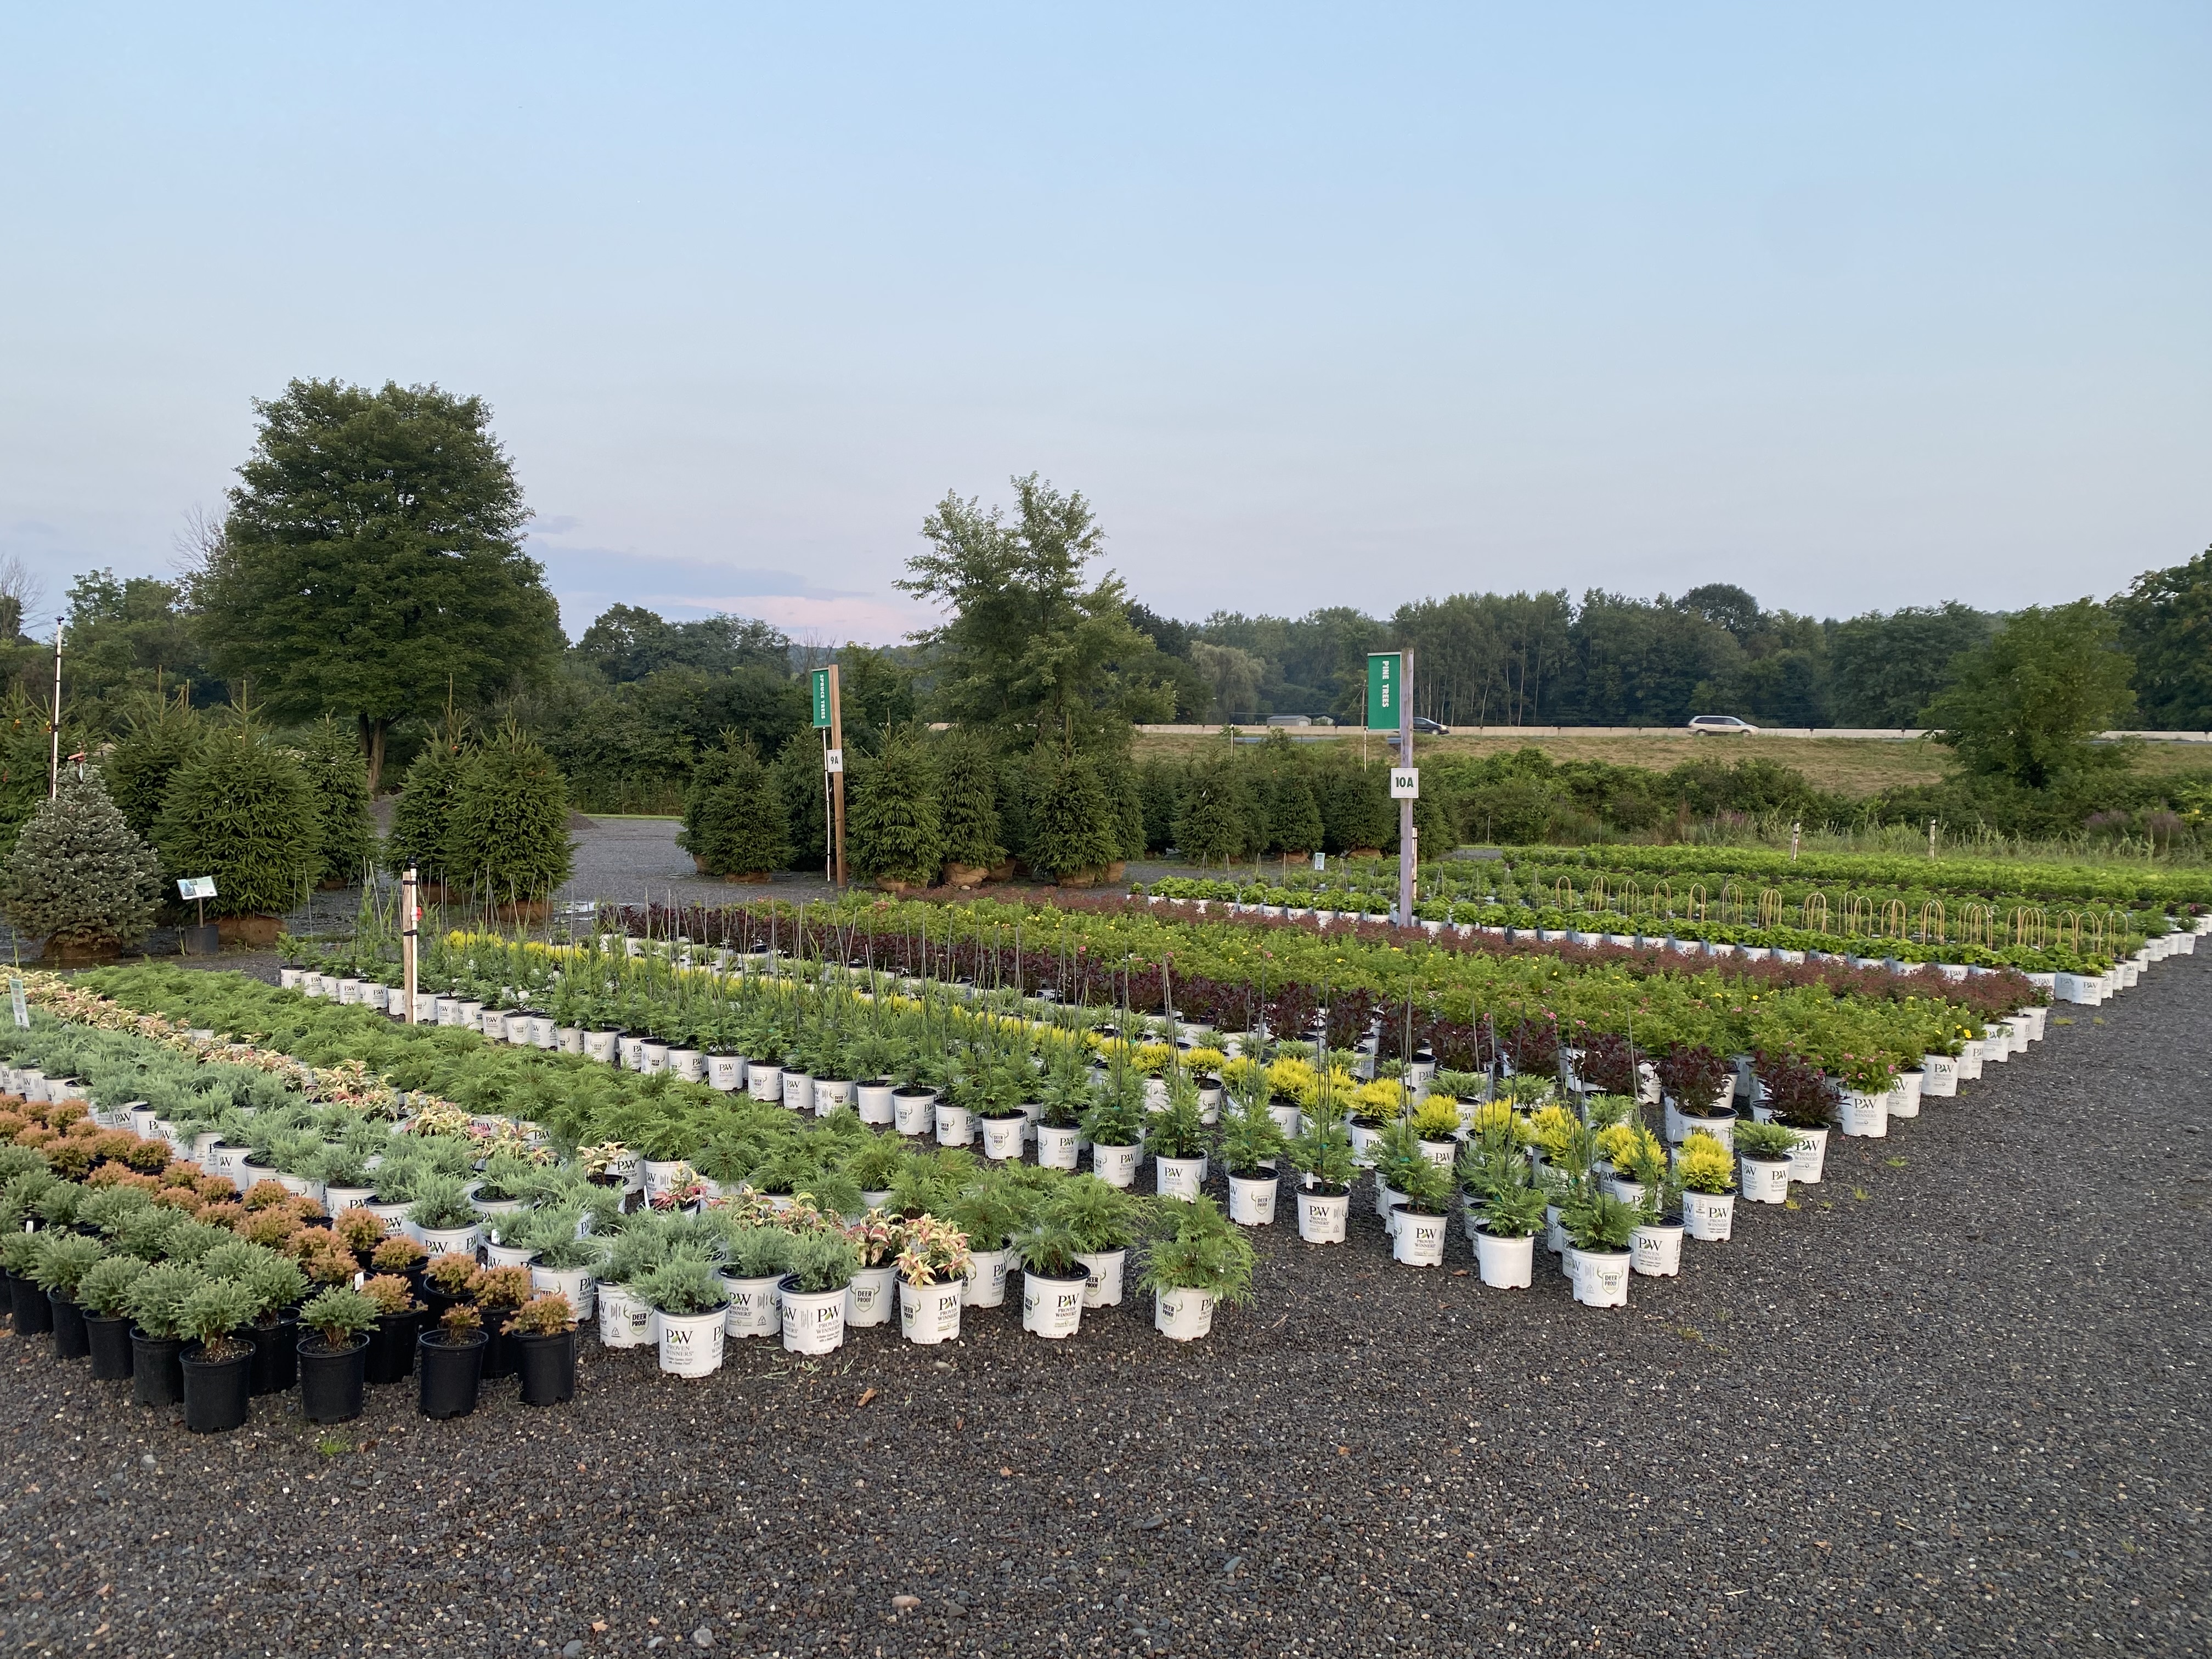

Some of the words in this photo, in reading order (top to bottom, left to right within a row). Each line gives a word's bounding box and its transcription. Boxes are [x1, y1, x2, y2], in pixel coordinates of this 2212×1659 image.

[1395, 777, 1414, 788] 10A
[719, 1063, 735, 1071] PW
[1934, 1064, 1954, 1073] PW
[787, 1080, 800, 1088] PW
[1854, 1098, 1877, 1109] PW
[115, 1112, 132, 1123] PW
[1060, 1137, 1075, 1147] PW
[1796, 1141, 1820, 1151] PW
[1120, 1153, 1135, 1164] PW
[617, 1160, 637, 1171] PW
[1165, 1167, 1183, 1177] PW
[1771, 1170, 1787, 1181] PW
[1309, 1205, 1329, 1217] PW
[1708, 1207, 1729, 1218] PW
[1416, 1228, 1437, 1239] PW
[425, 1239, 448, 1254] PW
[1638, 1237, 1663, 1251] PW
[994, 1262, 1007, 1277] PW
[579, 1277, 594, 1292] PW
[729, 1293, 752, 1306] PW
[939, 1294, 960, 1311] PW
[1057, 1293, 1080, 1308] PW
[940, 1308, 957, 1316] PROVEN
[1163, 1302, 1175, 1312] DEER
[632, 1313, 647, 1321] DEER
[817, 1303, 842, 1323] PW
[1163, 1310, 1174, 1318] PROOF
[816, 1323, 840, 1334] WINNERS
[819, 1319, 839, 1328] PROVEN
[665, 1328, 693, 1345] PW
[665, 1348, 694, 1357] WINNERS
